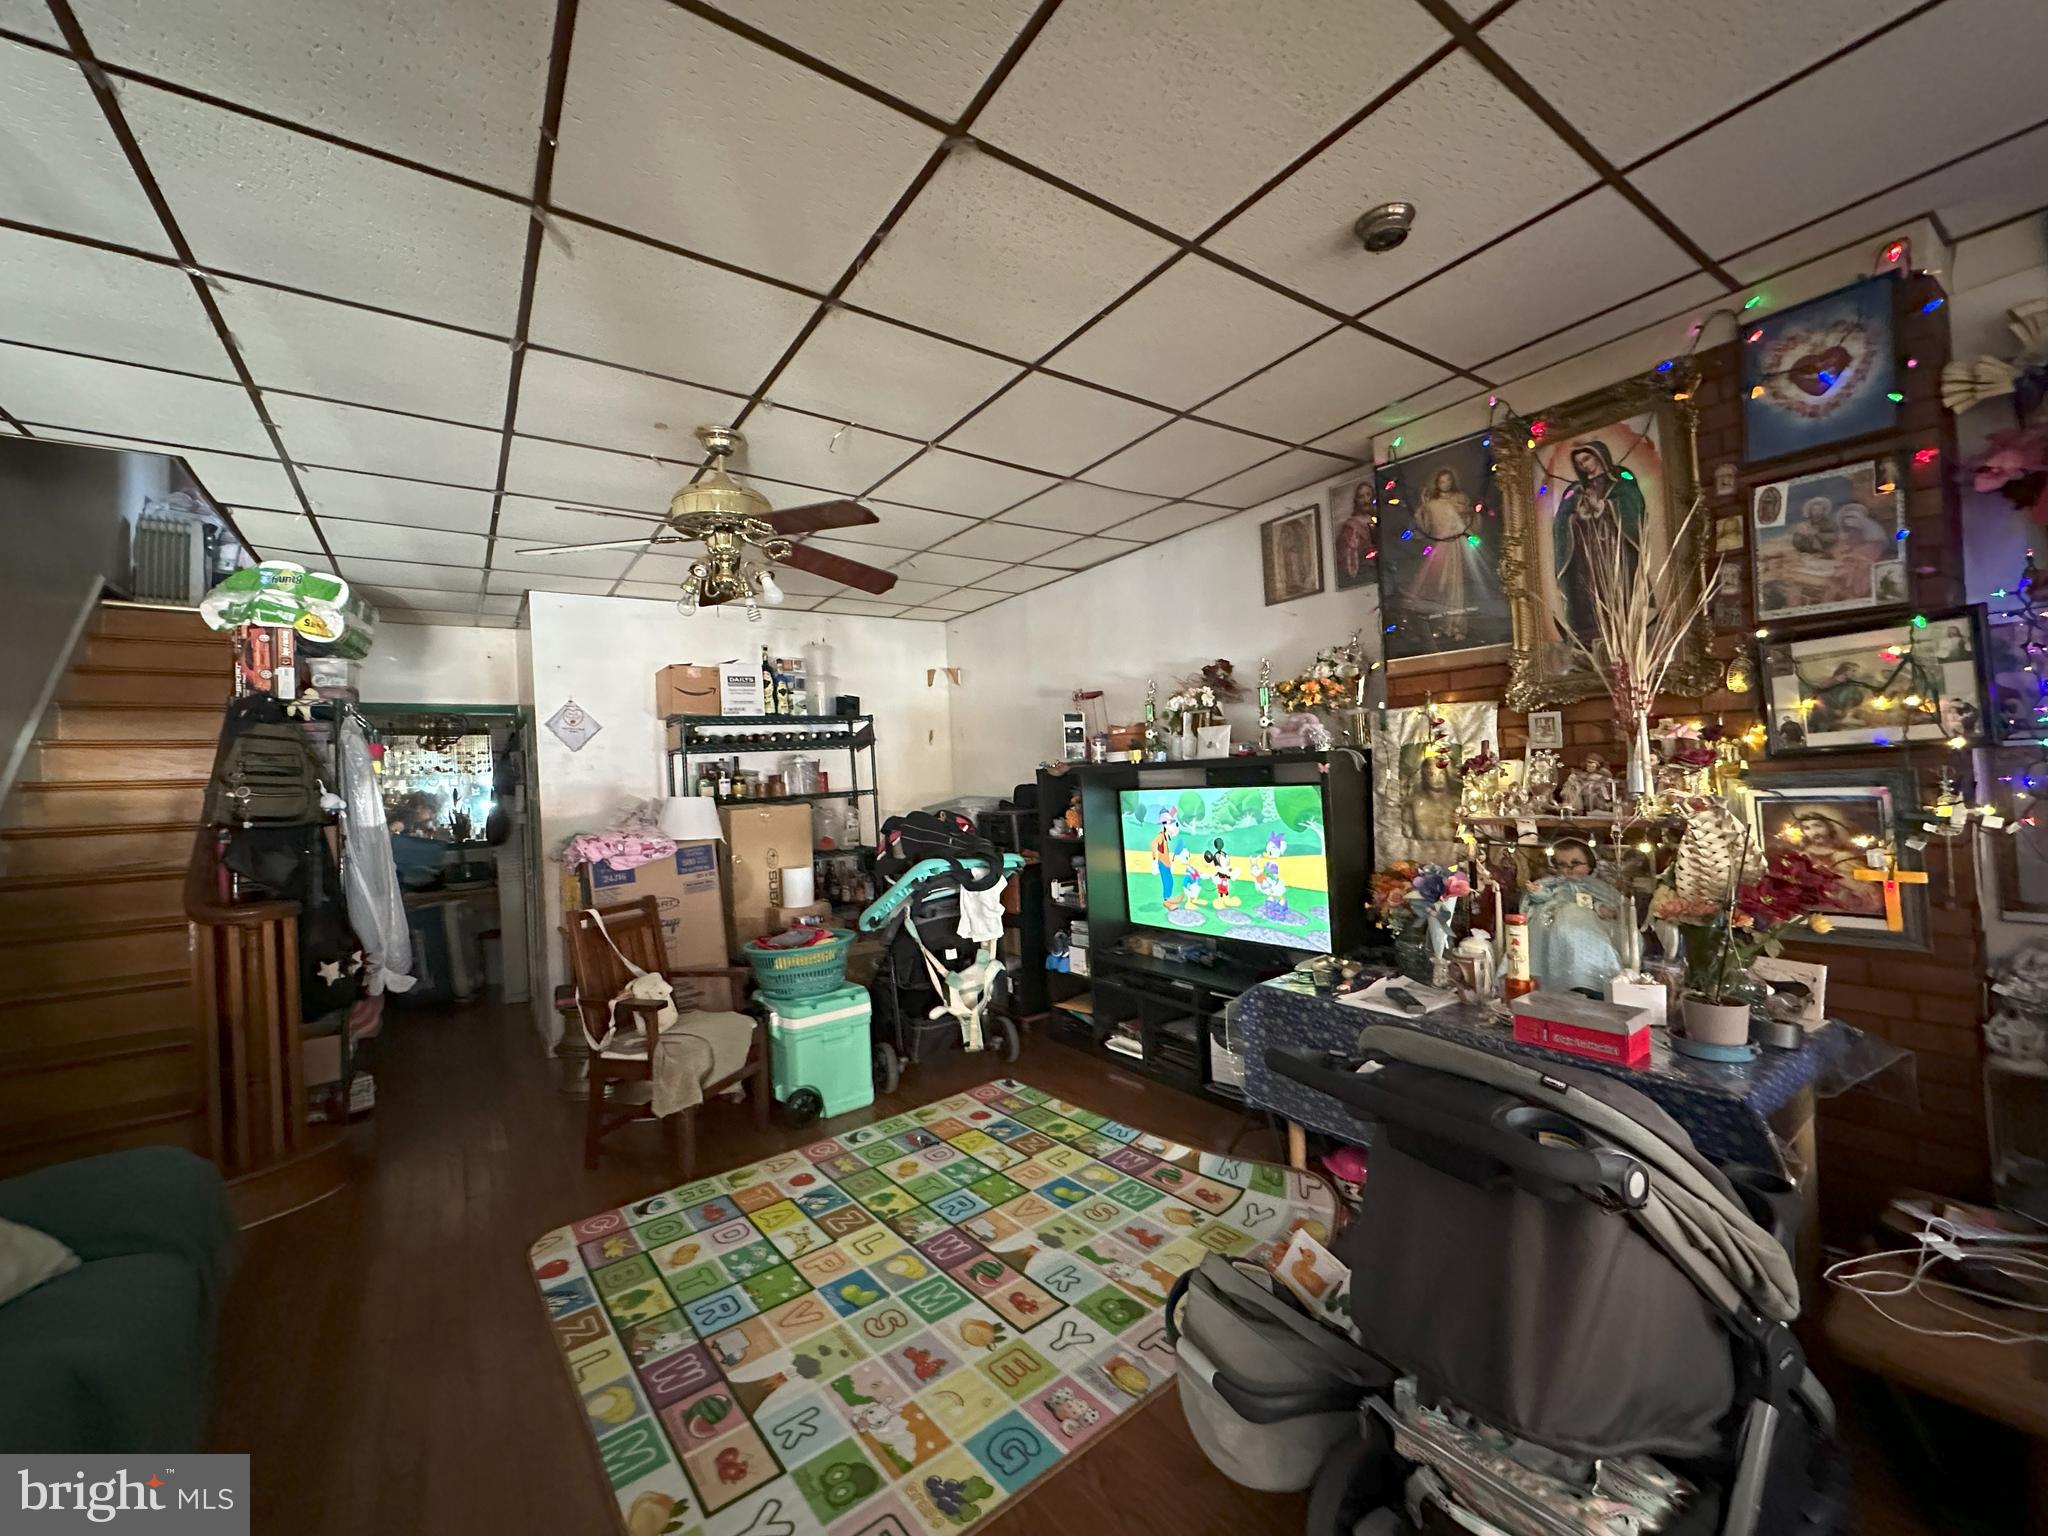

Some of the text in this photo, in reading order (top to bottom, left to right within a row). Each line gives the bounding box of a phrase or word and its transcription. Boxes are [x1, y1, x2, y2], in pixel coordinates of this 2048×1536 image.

[924, 1146, 956, 1162] D
[1015, 1137, 1050, 1156] Z
[766, 1157, 797, 1172] A
[1047, 1150, 1072, 1168] L
[1112, 1151, 1150, 1170] W
[1012, 1164, 1048, 1181] P
[938, 1195, 976, 1217] R
[1113, 1182, 1156, 1206] M
[759, 1208, 794, 1228] A
[1014, 1199, 1048, 1217] V
[1084, 1202, 1120, 1222] S
[1242, 1202, 1276, 1228] Y
[647, 1220, 684, 1240] O
[712, 1222, 750, 1244] D
[826, 1210, 866, 1233] Z
[852, 1231, 886, 1256] L
[928, 1233, 972, 1260] W
[1199, 1226, 1242, 1250] E
[802, 1252, 846, 1274] P
[676, 1267, 718, 1291] T
[1044, 1265, 1081, 1292] K
[694, 1294, 742, 1326] R
[911, 1282, 962, 1314] M
[779, 1300, 824, 1328] V
[864, 1308, 908, 1338] S
[1050, 1320, 1094, 1350] Y
[652, 1353, 707, 1394] W
[988, 1348, 1042, 1387] E
[772, 1406, 820, 1450] K
[986, 1426, 1041, 1476] G
